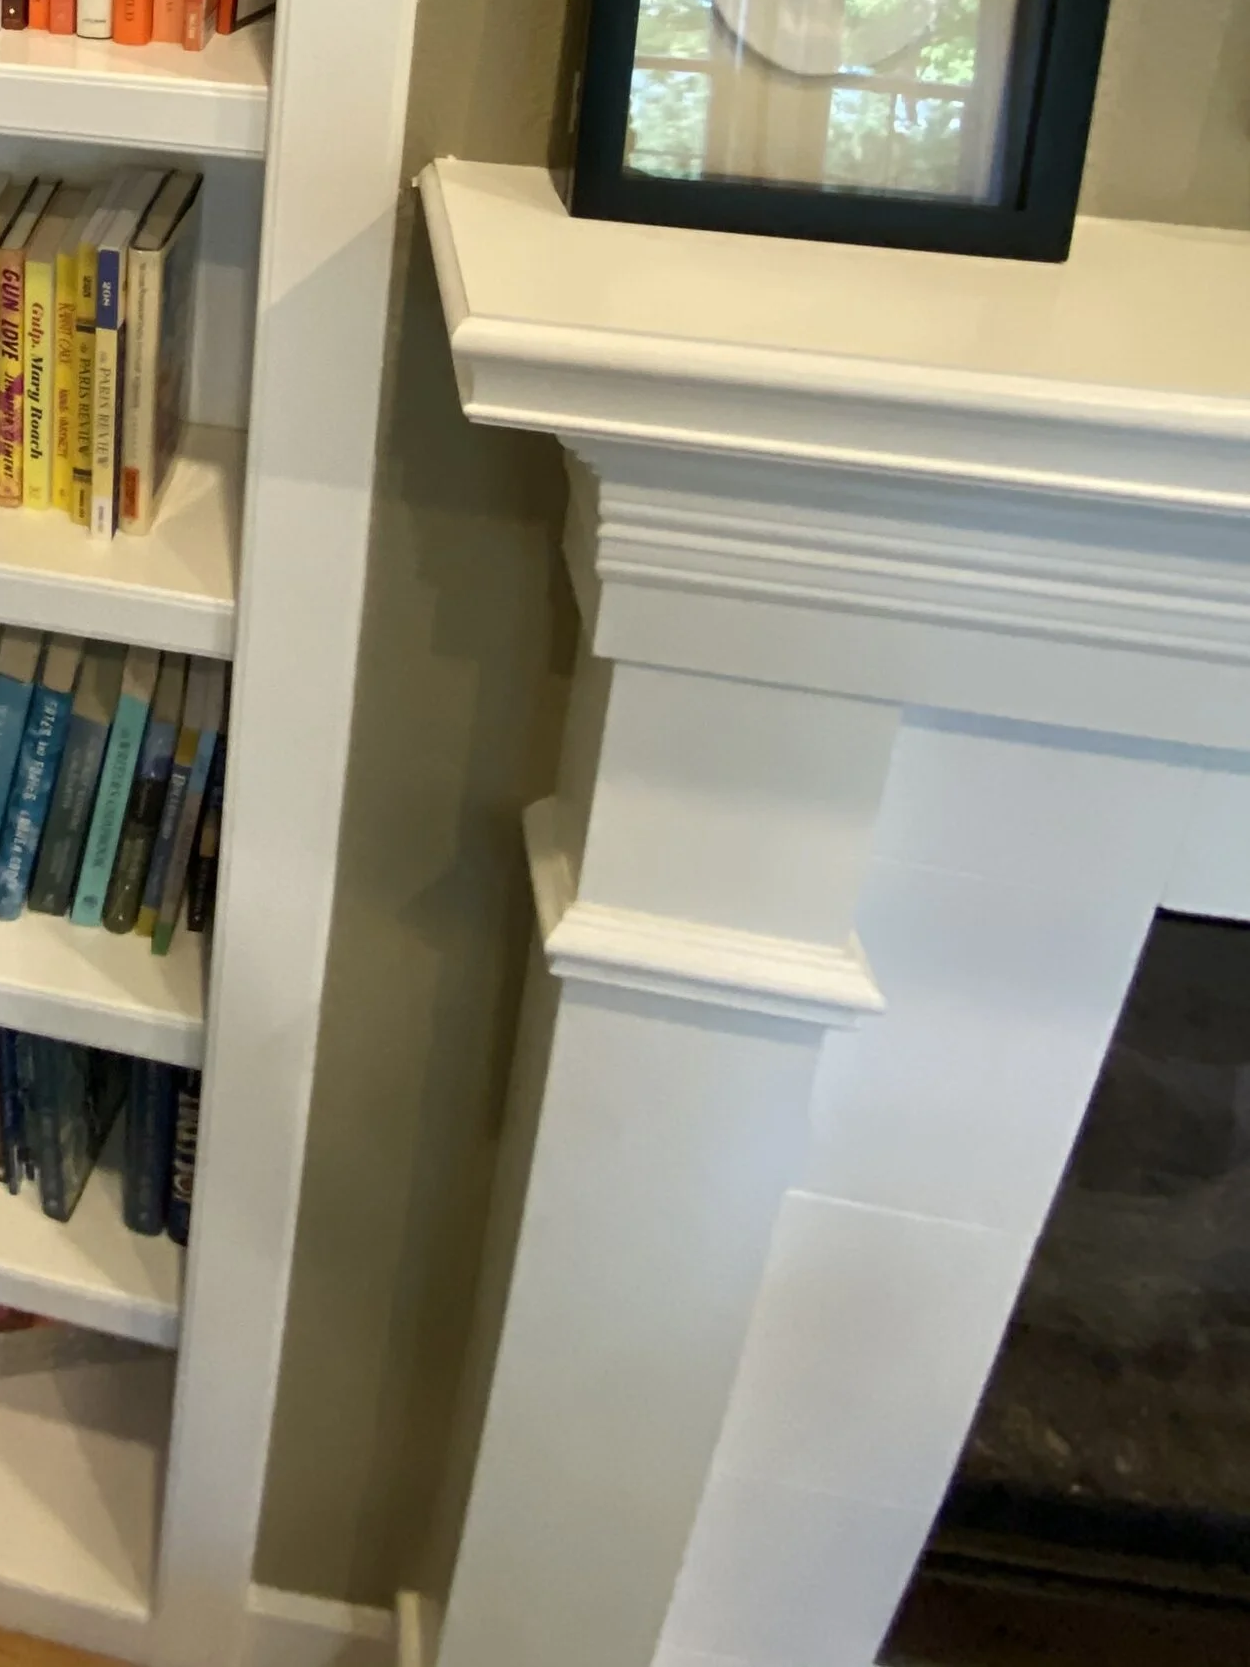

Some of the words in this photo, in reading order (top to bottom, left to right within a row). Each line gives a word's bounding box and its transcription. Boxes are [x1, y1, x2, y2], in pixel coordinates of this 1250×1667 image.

[2, 268, 20, 312] GUN
[1, 317, 20, 362] LOVE
[27, 302, 45, 349] Gulp.
[27, 352, 44, 404] Mary
[77, 356, 92, 399] PARIS
[98, 366, 112, 410] PARIS
[28, 405, 43, 460] Roach
[77, 401, 91, 458] REVIEW
[97, 412, 111, 465] REVIEW
